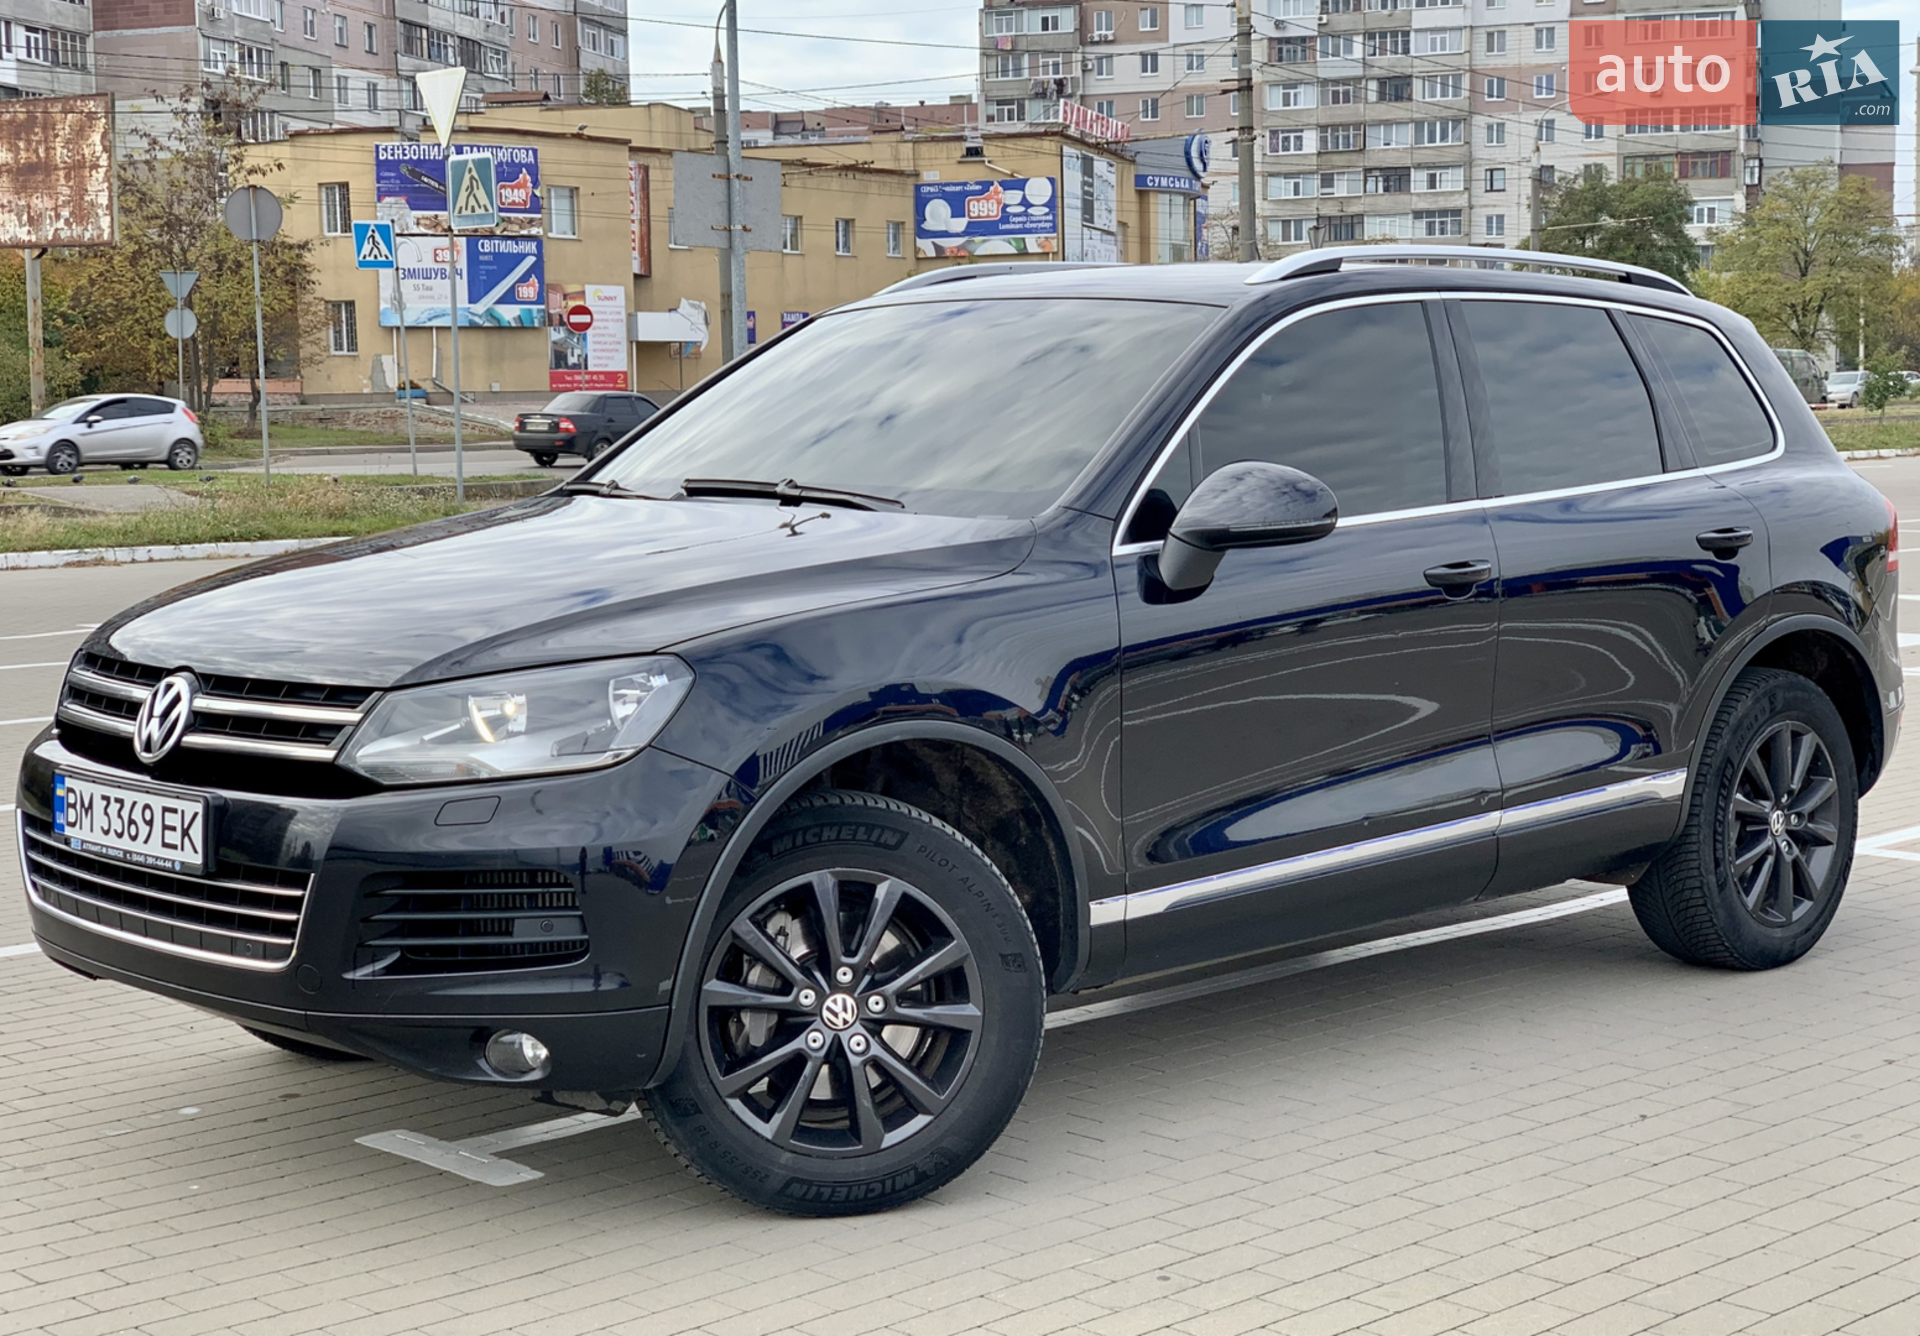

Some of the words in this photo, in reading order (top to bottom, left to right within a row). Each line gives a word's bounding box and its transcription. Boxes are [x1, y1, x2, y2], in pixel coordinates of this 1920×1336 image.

[1146, 176, 1190, 189] СУМСЬКА
[500, 188, 527, 204] 1949
[969, 199, 998, 218] 999
[478, 239, 538, 254] СВІТИЛЬНИК
[518, 286, 535, 298] 199
[66, 786, 94, 833] BM
[100, 794, 154, 845] 3369
[161, 805, 200, 855] EK
[771, 825, 901, 856] MICHELIN
[916, 844, 959, 873] PILOT
[957, 876, 995, 913] ALPIN
[996, 921, 1013, 944] SUV
[718, 1149, 771, 1183] 255/55
[785, 1169, 917, 1202] MICHELIN
